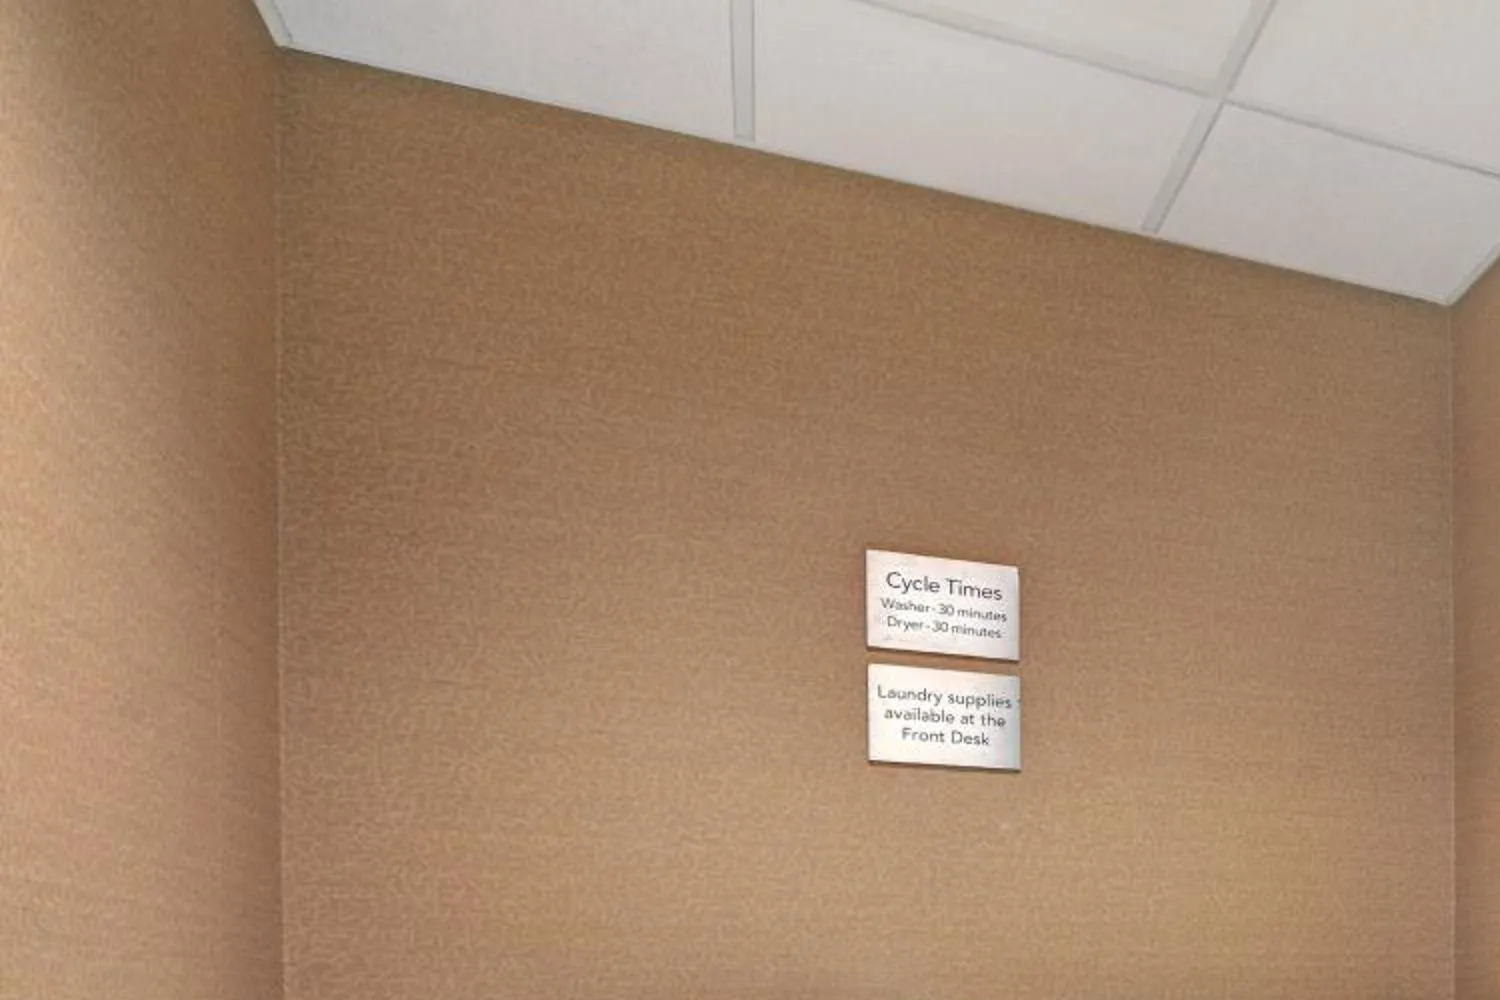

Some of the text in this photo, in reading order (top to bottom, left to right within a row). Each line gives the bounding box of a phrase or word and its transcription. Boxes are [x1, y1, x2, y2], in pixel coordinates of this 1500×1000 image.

[886, 571, 1003, 601] Cycle Times
[938, 603, 955, 616] 30
[957, 607, 1007, 623] minutes
[932, 620, 949, 633] 30
[951, 624, 1002, 639] minutes
[877, 684, 1012, 709] Laundry supplies
[884, 707, 1006, 727] available at the
[902, 727, 990, 745] Front Desk
